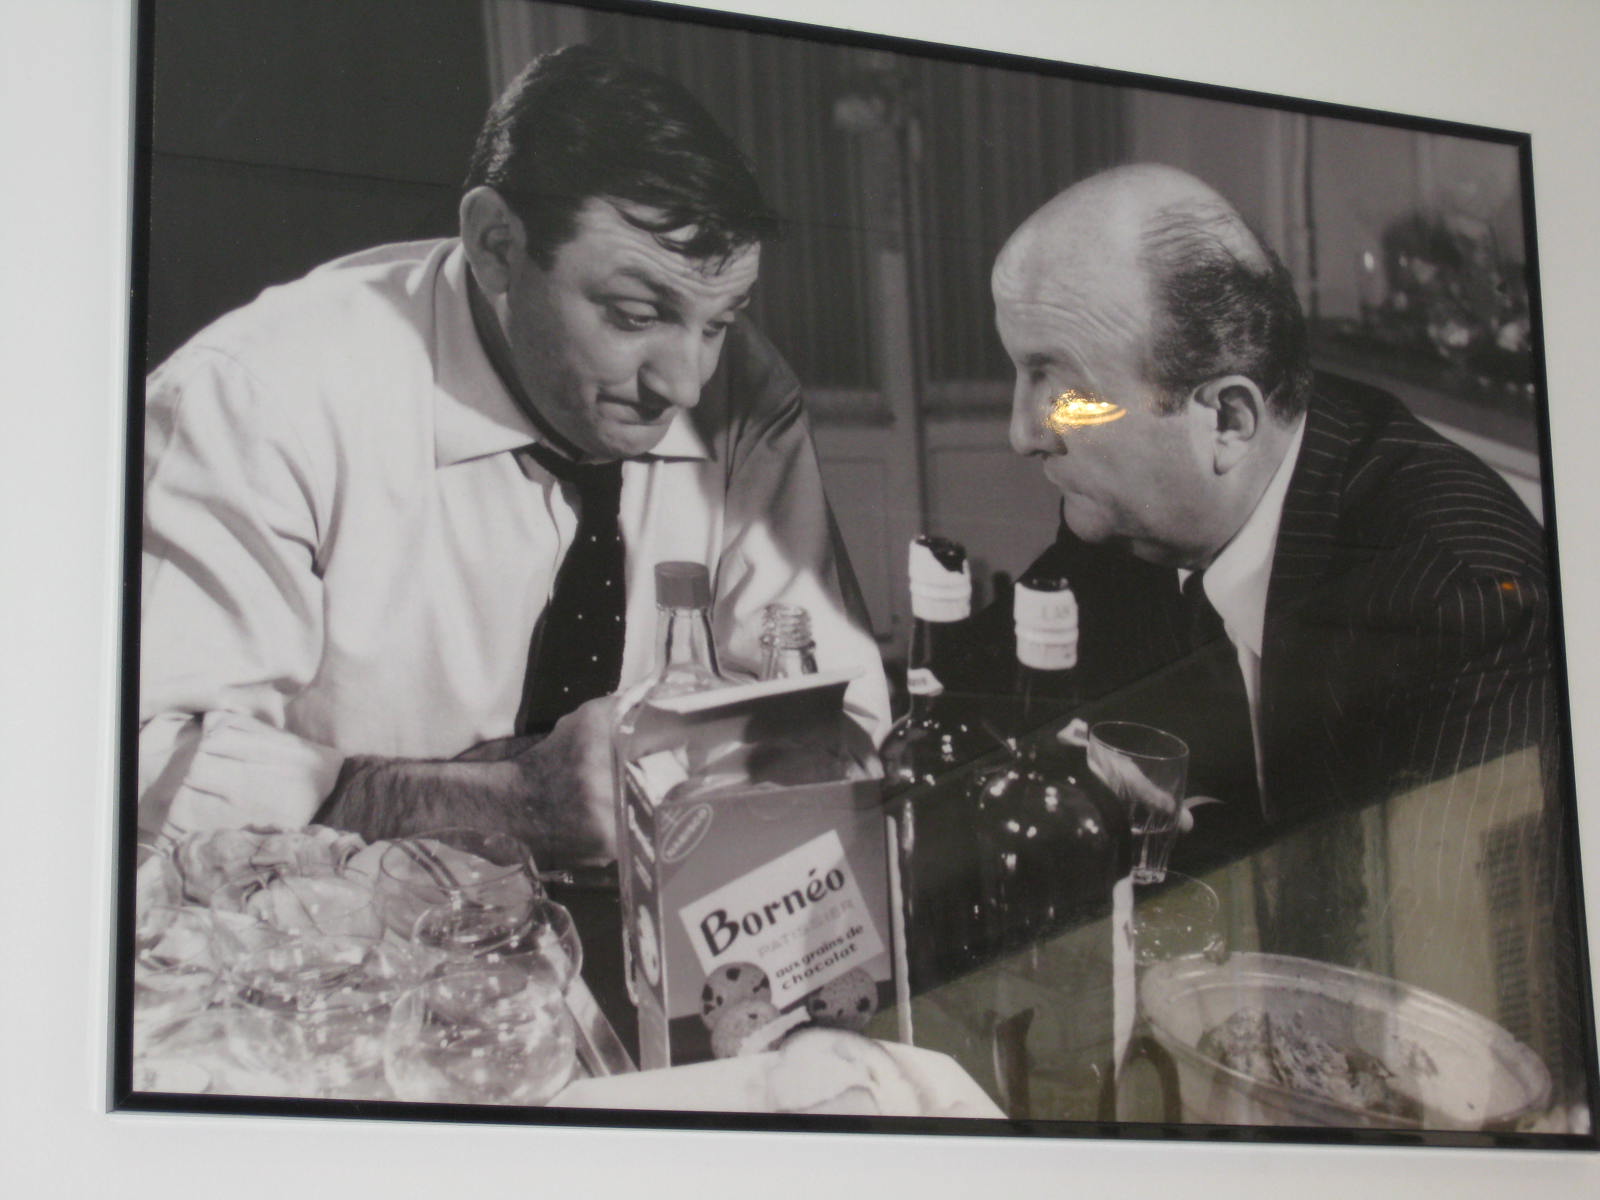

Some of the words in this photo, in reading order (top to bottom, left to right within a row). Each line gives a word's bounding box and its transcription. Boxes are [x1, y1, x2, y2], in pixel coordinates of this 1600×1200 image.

[700, 868, 845, 957] Bornéo
[776, 961, 800, 978] aux
[802, 936, 844, 965] grains
[846, 925, 863, 940] de
[782, 943, 857, 990] chocolat
